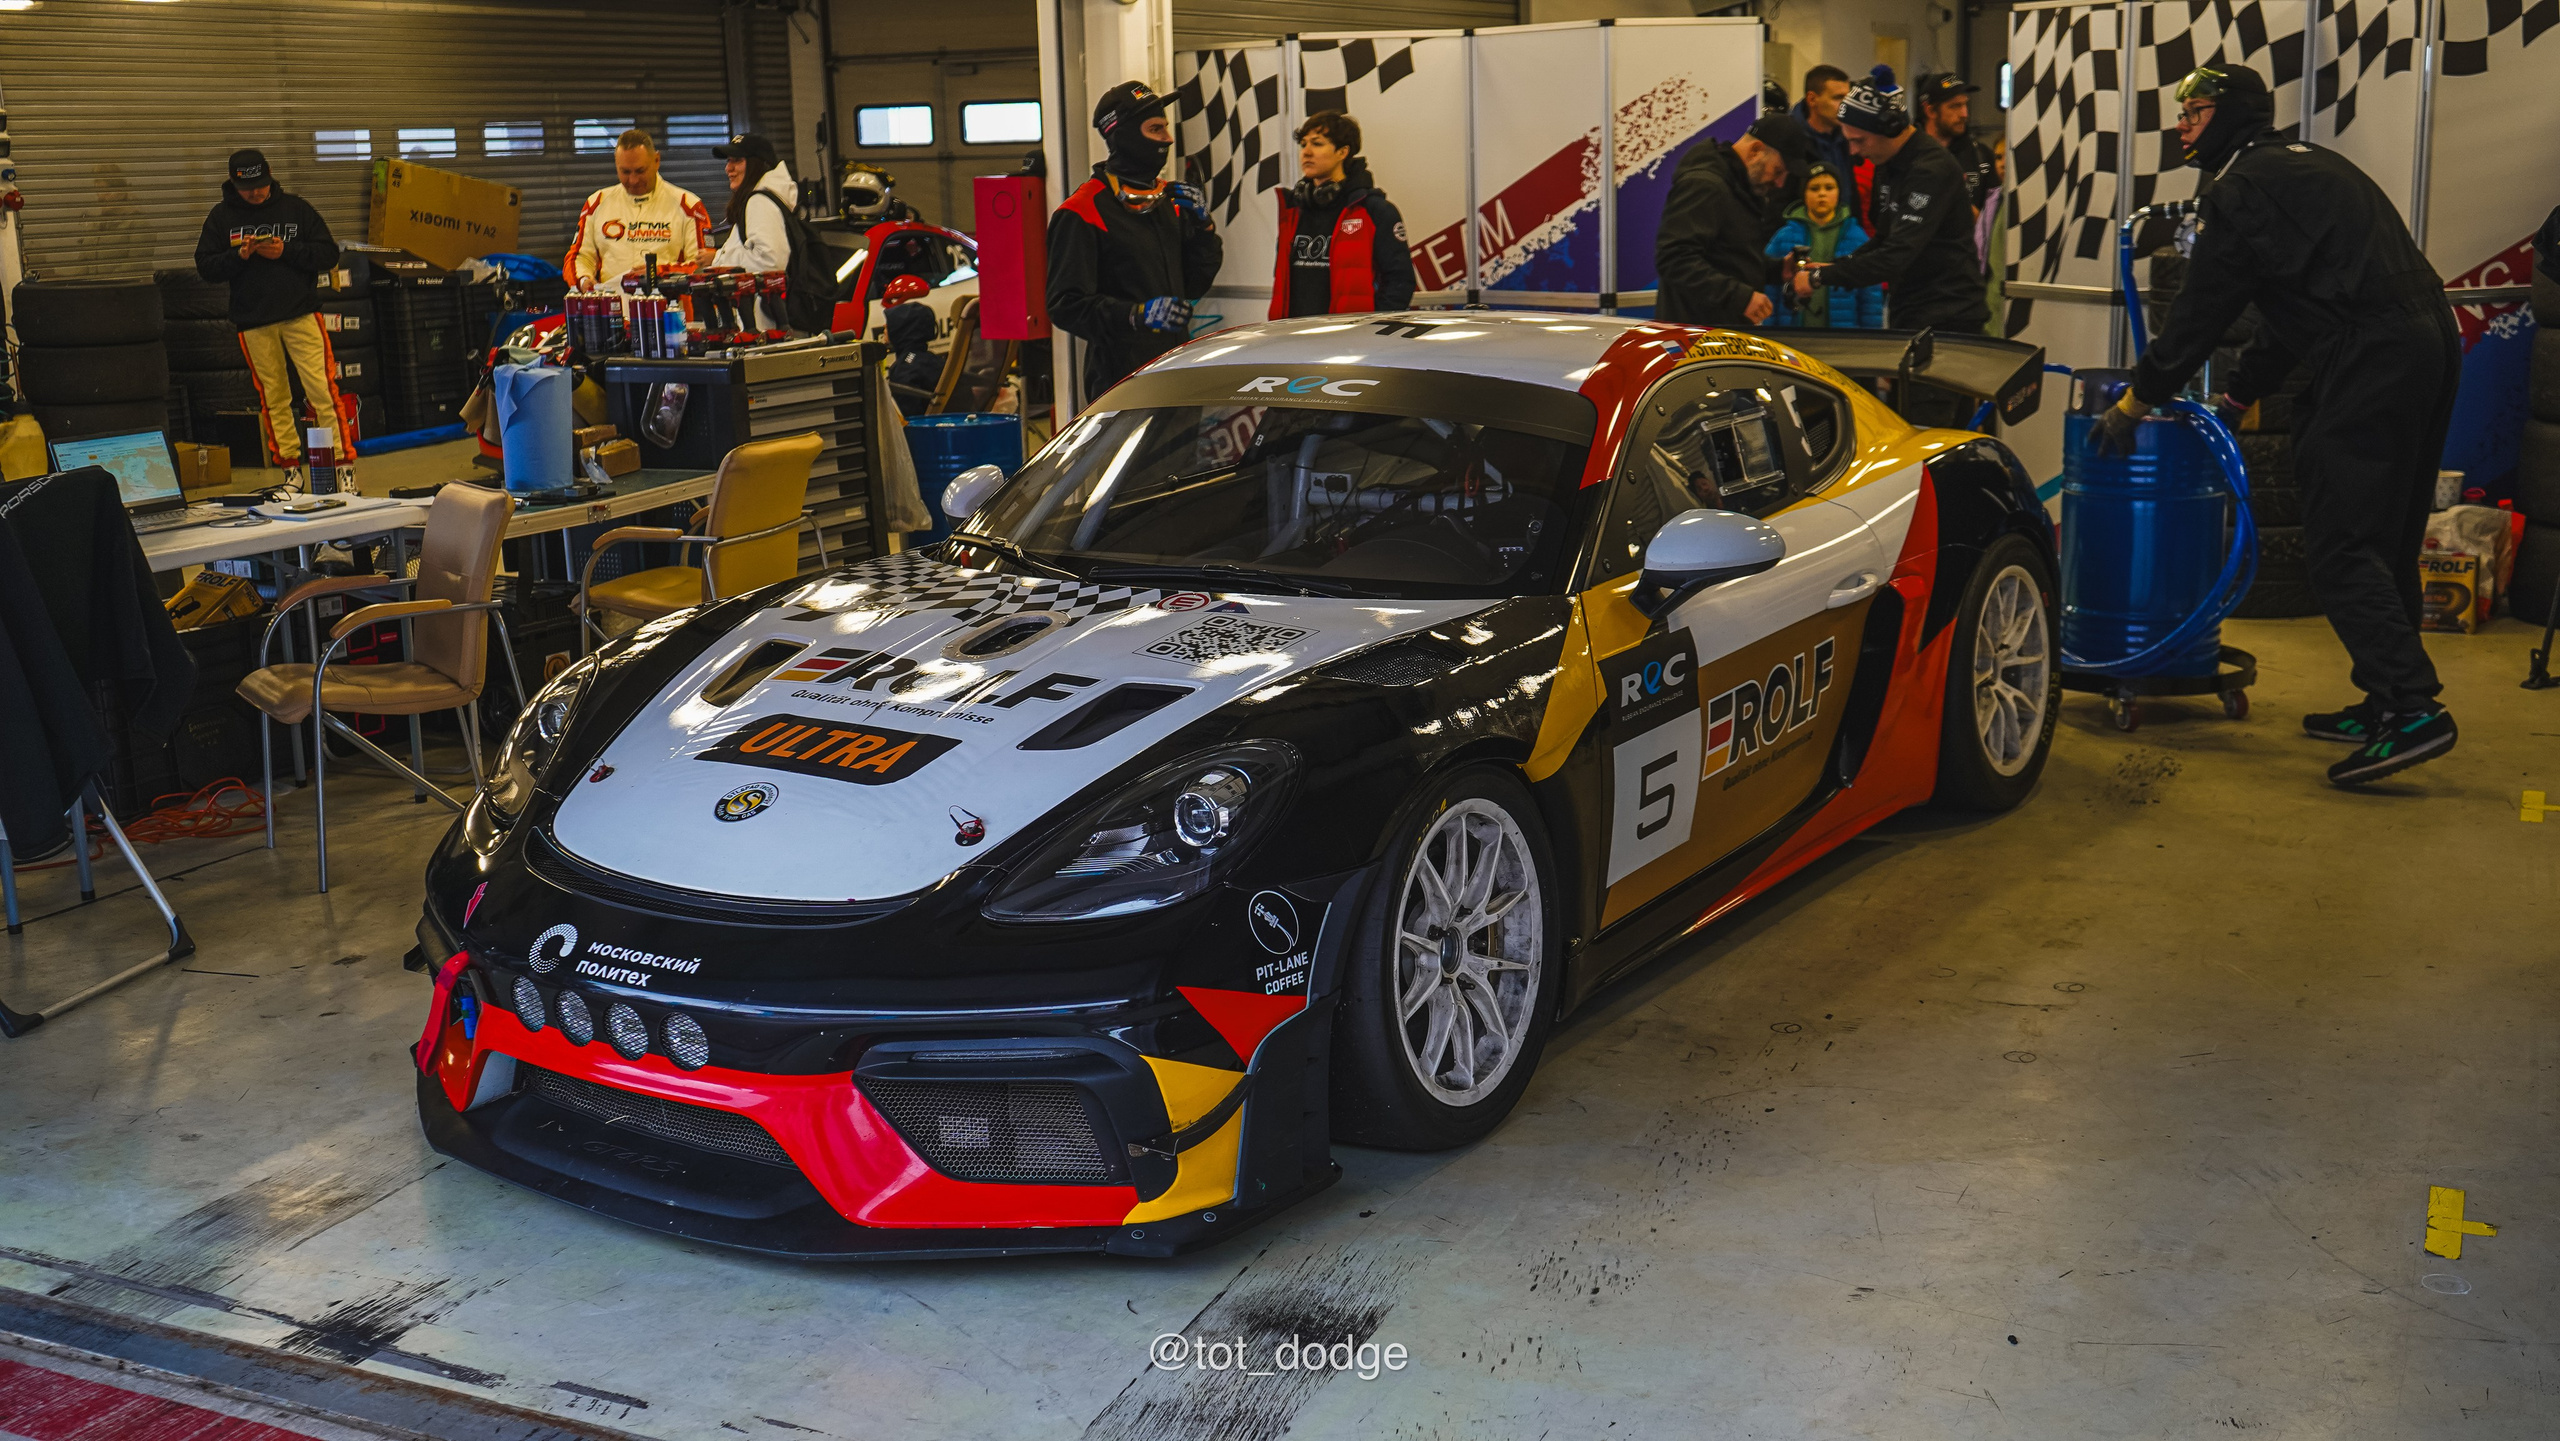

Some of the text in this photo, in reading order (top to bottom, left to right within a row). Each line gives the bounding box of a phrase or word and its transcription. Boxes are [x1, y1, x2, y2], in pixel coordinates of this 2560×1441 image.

[466, 220, 482, 235] TV
[483, 226, 497, 239] A2
[2428, 560, 2475, 574] ROLF
[201, 572, 239, 589] ROLF
[790, 688, 850, 706] Qualität
[1728, 636, 1835, 765] ROLF
[739, 721, 918, 774] ULTRA
[1636, 749, 1678, 840] 5
[741, 811, 757, 819] GAS
[1255, 951, 1310, 981] PIT-LANE
[1265, 970, 1305, 996] COFFEE
